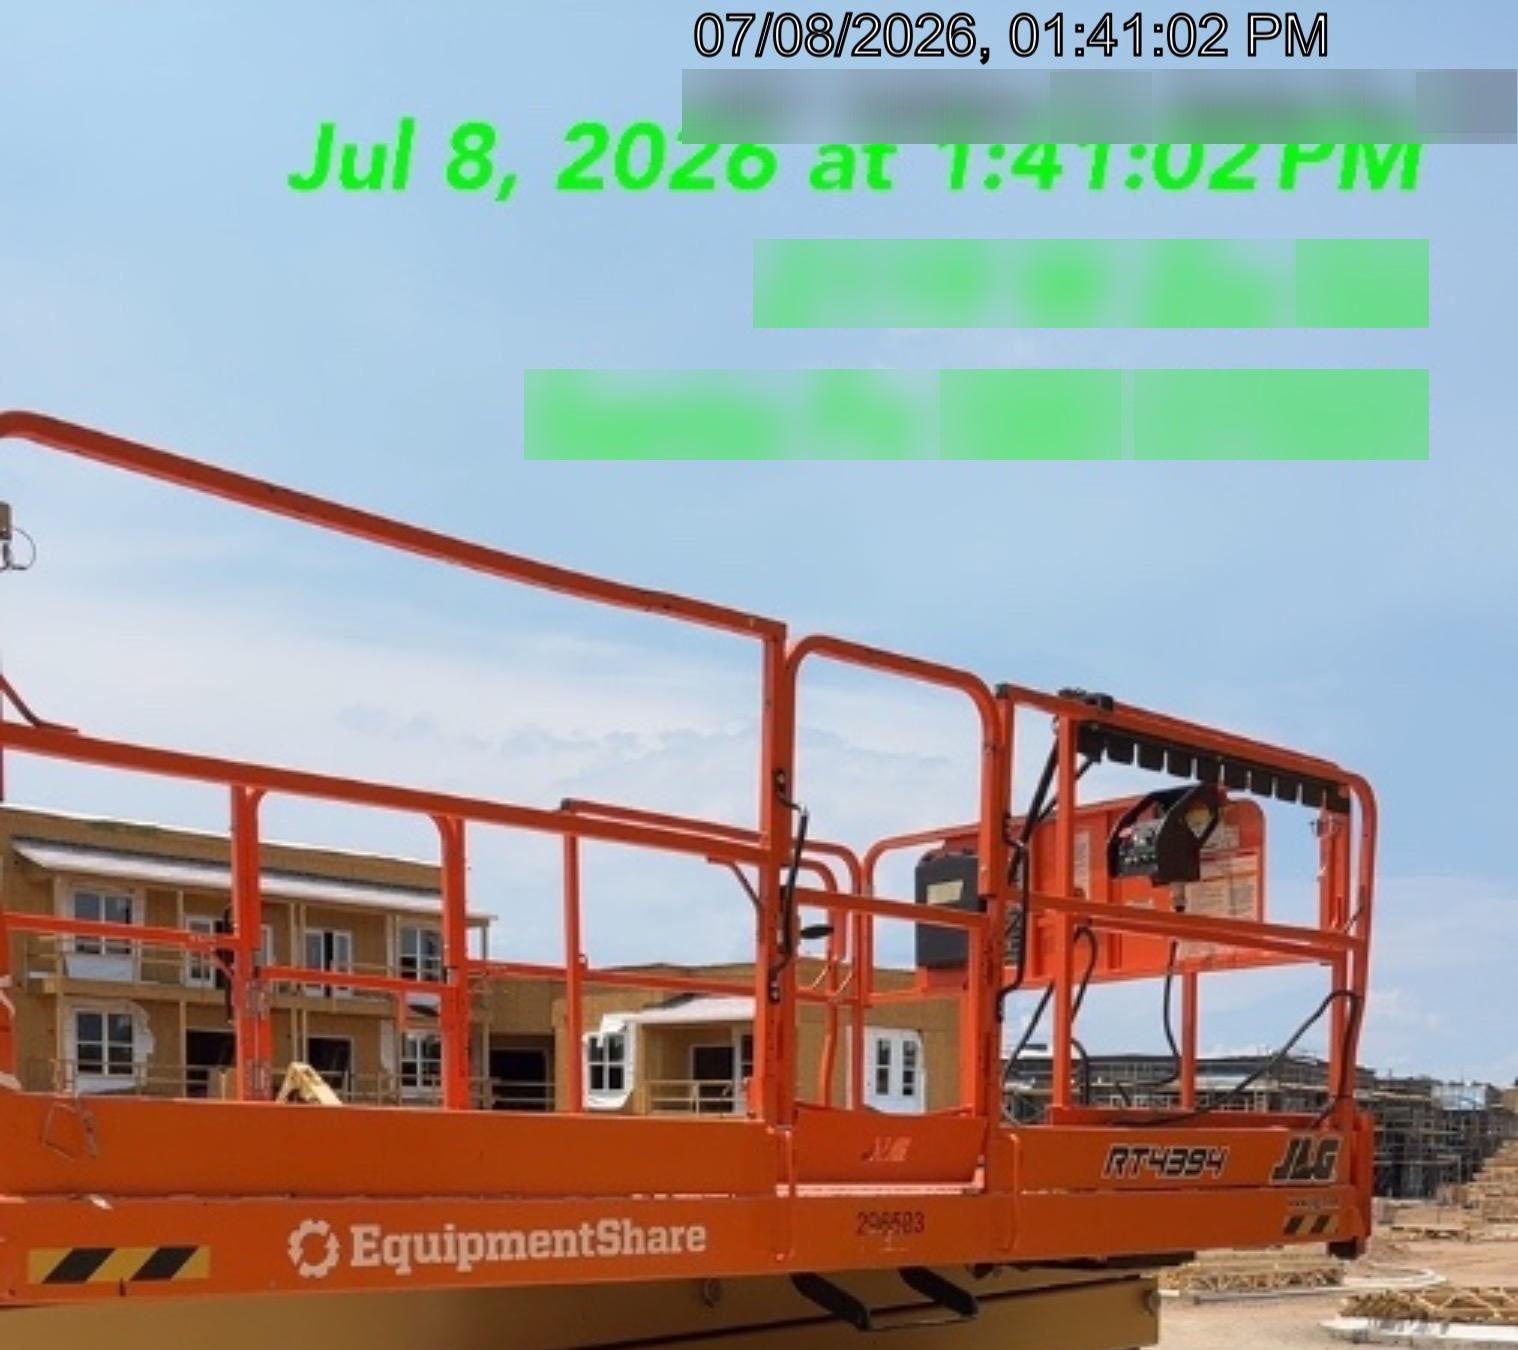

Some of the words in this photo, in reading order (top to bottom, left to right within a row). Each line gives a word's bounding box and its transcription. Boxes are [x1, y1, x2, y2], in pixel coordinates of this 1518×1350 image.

[1103, 1143, 1230, 1179] RT4394
[1269, 1135, 1340, 1185] JLG
[350, 1219, 707, 1275] EquipmentShare
